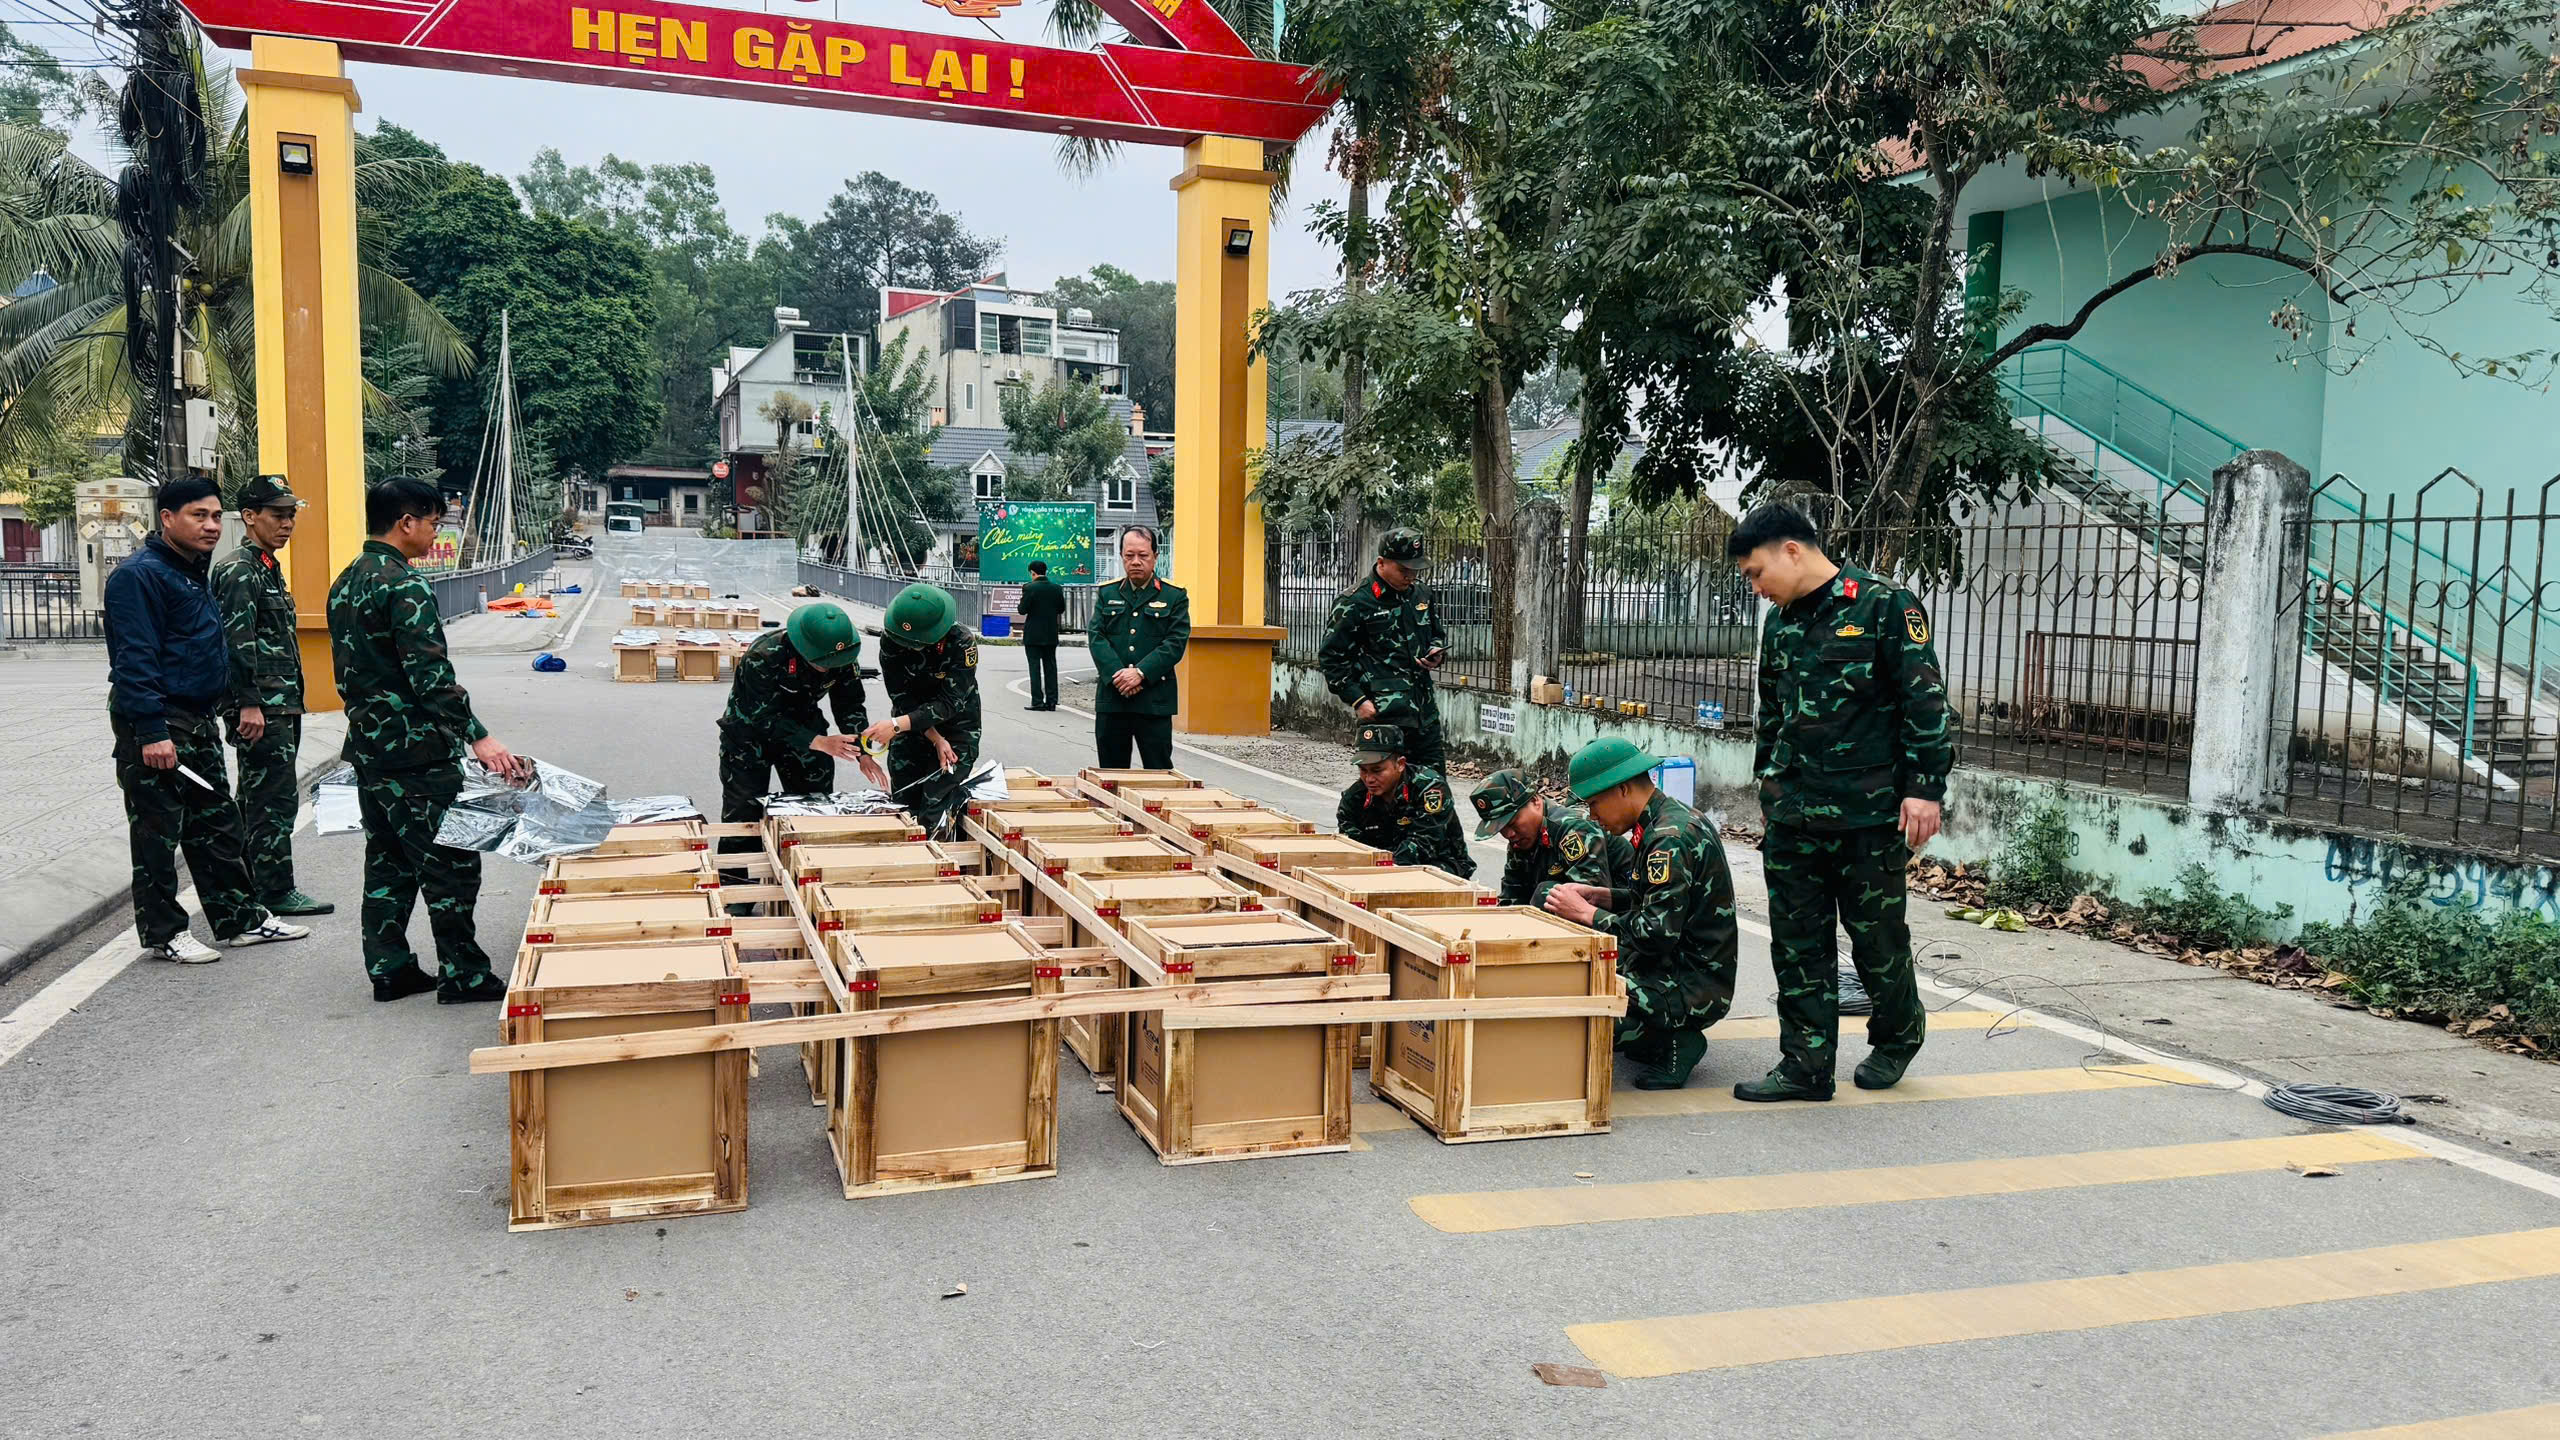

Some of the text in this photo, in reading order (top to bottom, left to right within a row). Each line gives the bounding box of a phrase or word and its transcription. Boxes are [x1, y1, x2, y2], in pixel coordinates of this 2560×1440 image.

[572, 7, 1025, 98] HẸN GẶP LẠI !
[982, 527, 1014, 549] Chúc
